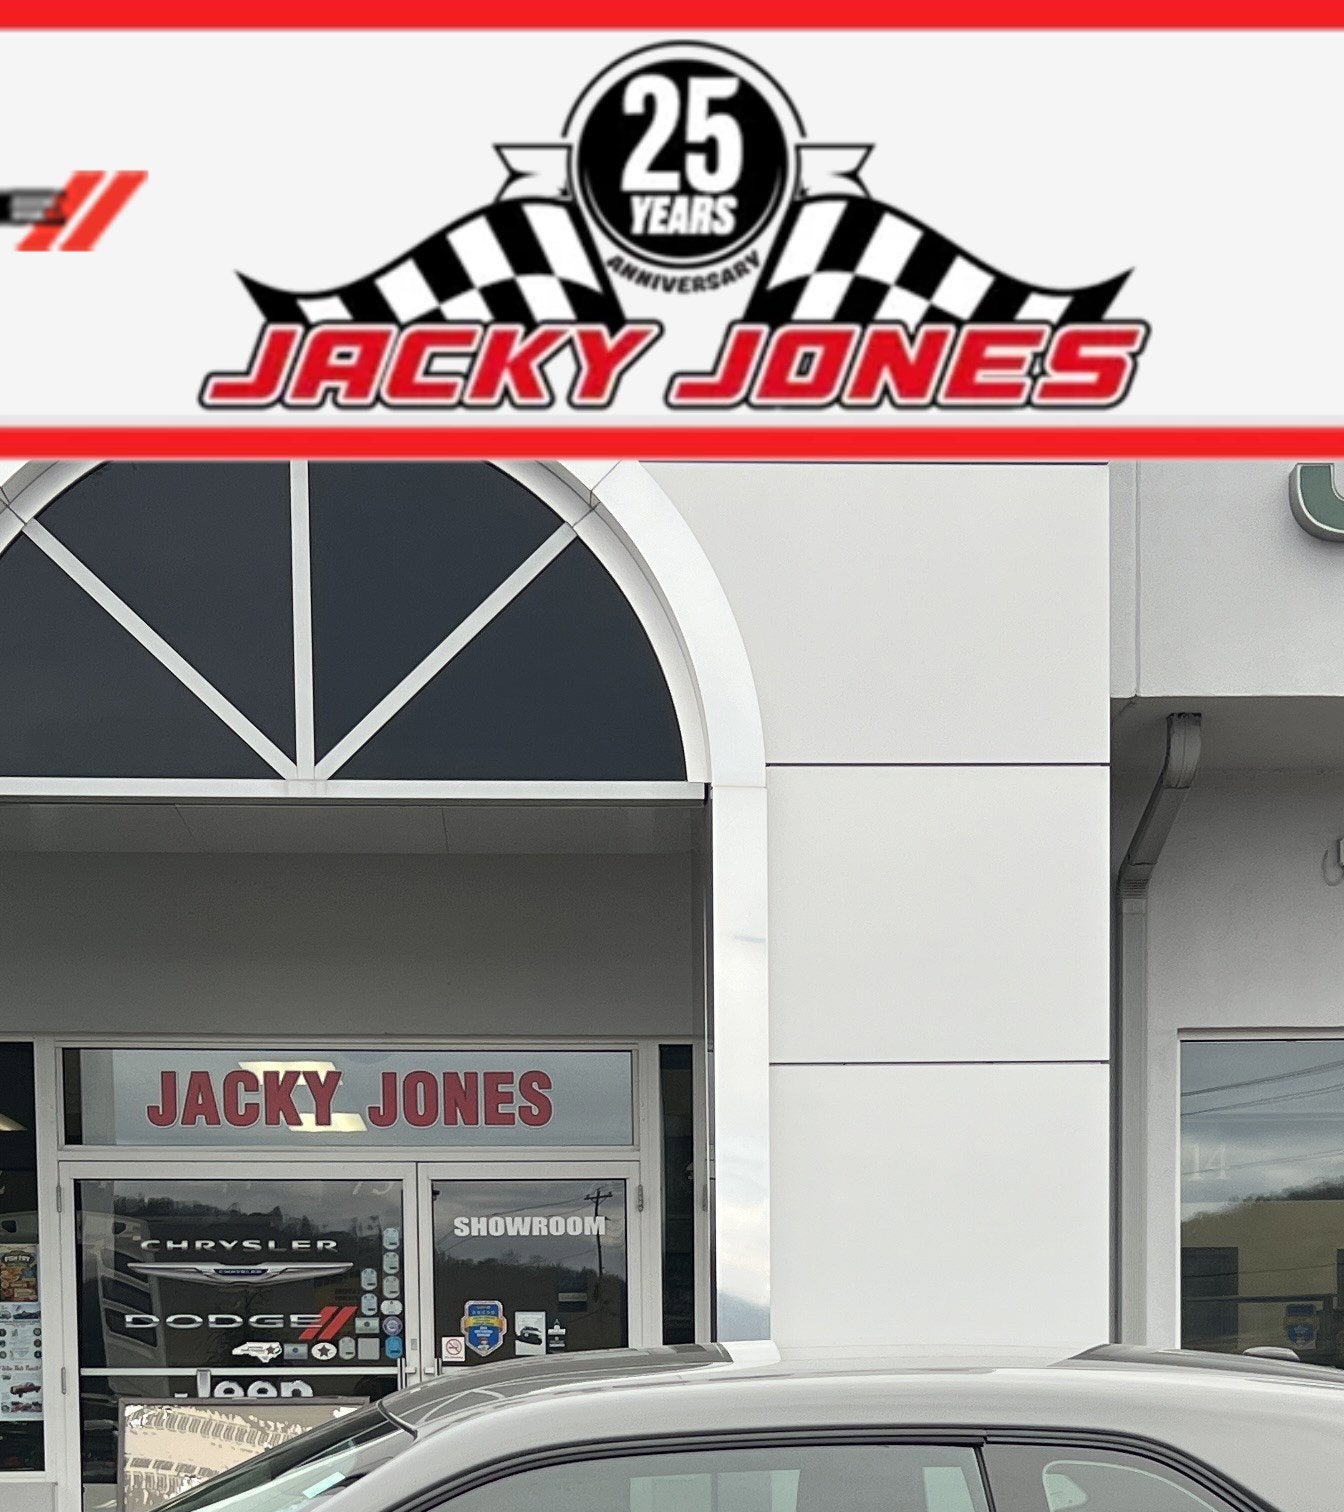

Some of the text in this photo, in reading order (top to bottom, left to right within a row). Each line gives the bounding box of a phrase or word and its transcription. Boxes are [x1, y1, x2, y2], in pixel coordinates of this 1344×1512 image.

[147, 1071, 552, 1127] JACKY JONES
[453, 1216, 606, 1237] SHOWROOM
[140, 1239, 338, 1252] CHRYSLER
[124, 1313, 324, 1329] DODGE
